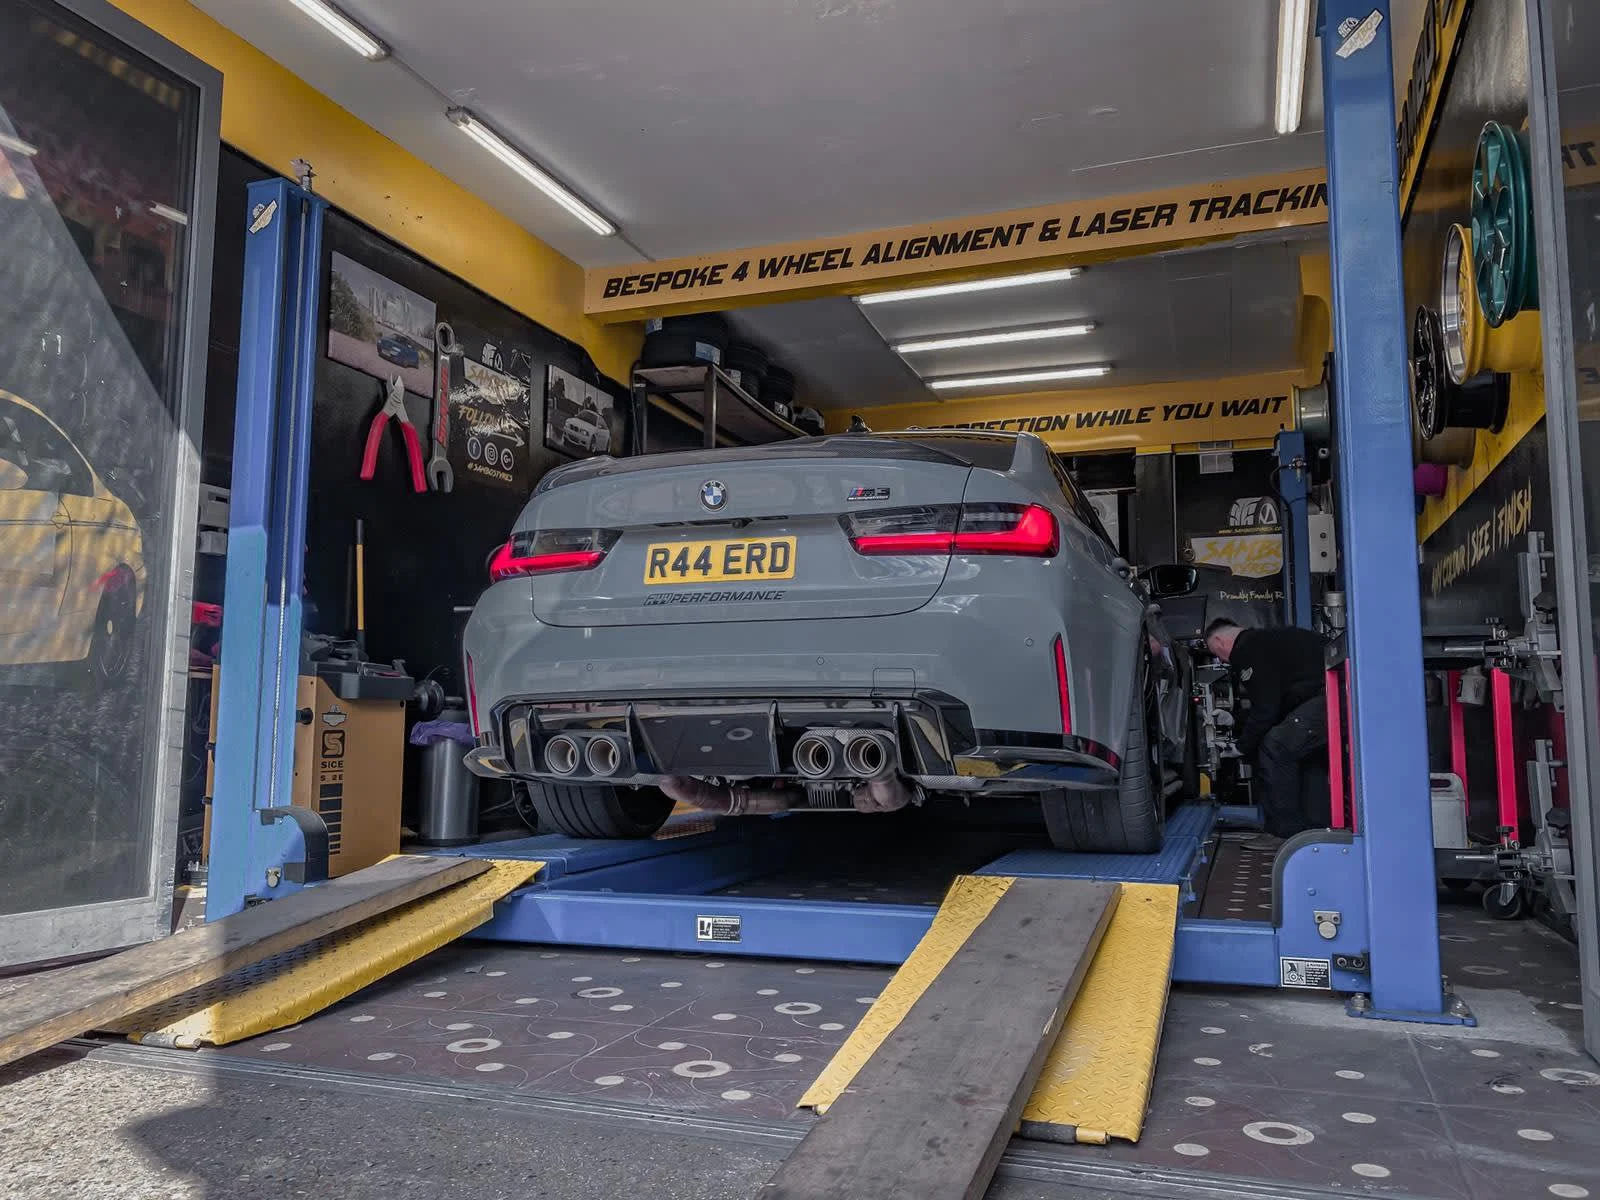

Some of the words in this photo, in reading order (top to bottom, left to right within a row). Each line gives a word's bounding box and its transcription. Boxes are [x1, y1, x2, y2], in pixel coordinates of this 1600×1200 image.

[603, 262, 725, 299] BESPOKE
[729, 259, 750, 283] 4
[756, 246, 856, 281] WHEEL
[860, 221, 1037, 267] ALIGNMENT
[1038, 216, 1062, 242] &
[1066, 202, 1179, 239] LASER
[1188, 182, 1328, 223] TRACKIN
[1075, 406, 1156, 429] WHILE
[1162, 401, 1214, 422] YOU
[1220, 395, 1289, 417] WAIT
[1471, 519, 1491, 567] SIZE
[1497, 476, 1533, 549] FINISH
[649, 546, 713, 578] R44
[722, 541, 790, 575] ERD
[671, 590, 787, 604] PERFORMANCE
[320, 760, 344, 768] SICE
